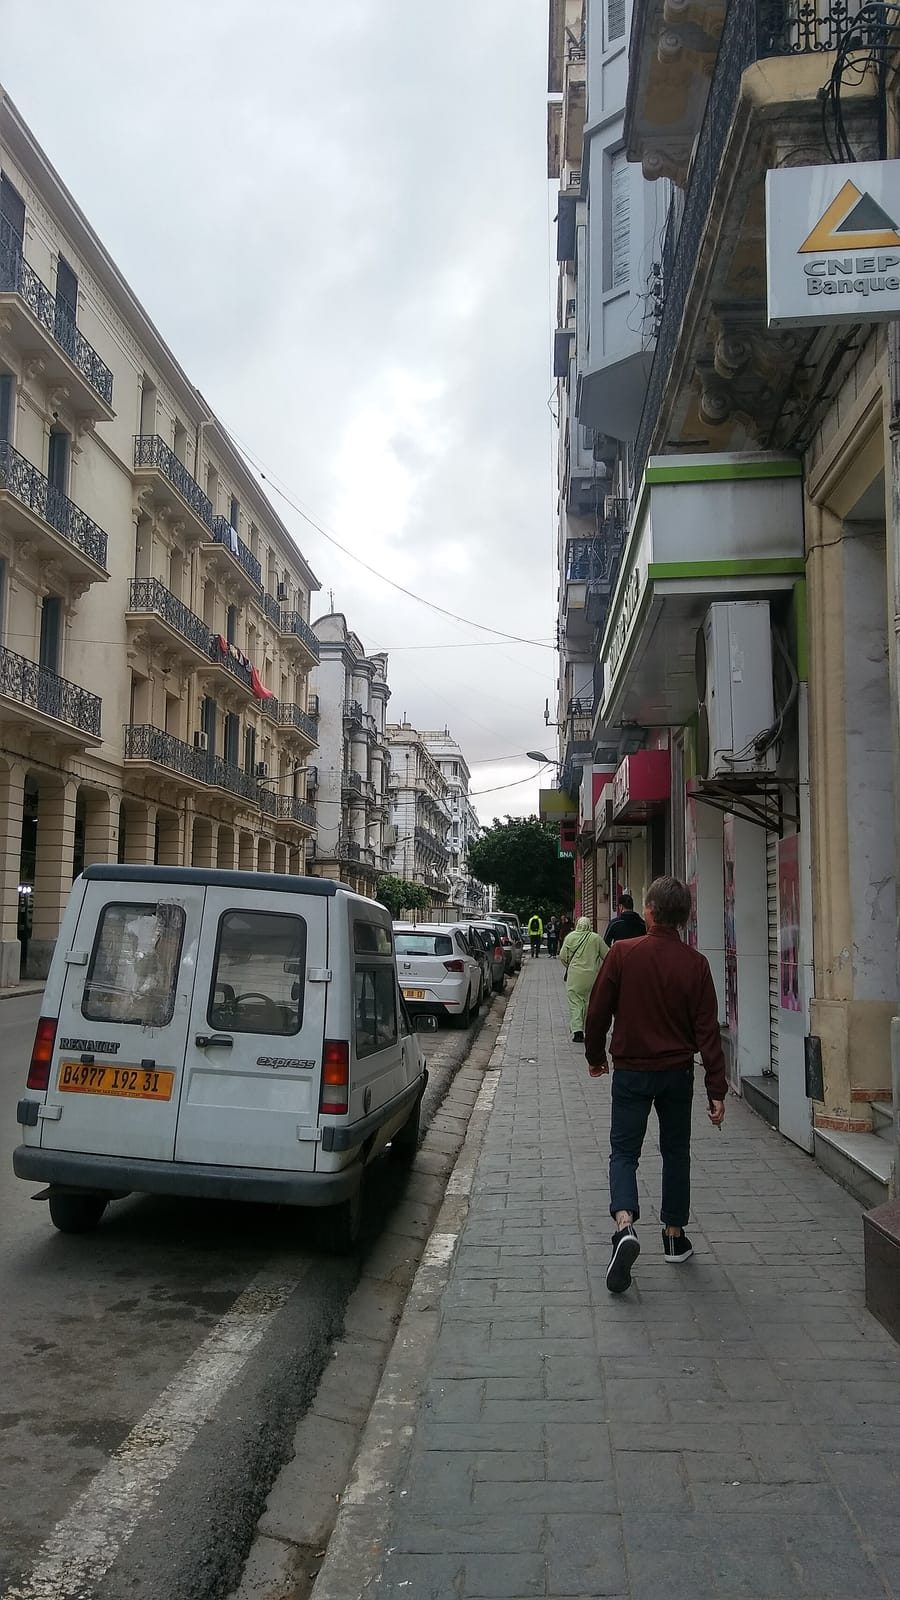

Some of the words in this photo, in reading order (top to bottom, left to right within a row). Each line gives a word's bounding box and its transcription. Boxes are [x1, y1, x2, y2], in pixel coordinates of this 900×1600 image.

[804, 255, 900, 276] CNEP
[807, 276, 900, 296] Banque
[60, 1038, 120, 1054] RENAULT
[257, 1056, 316, 1069] express
